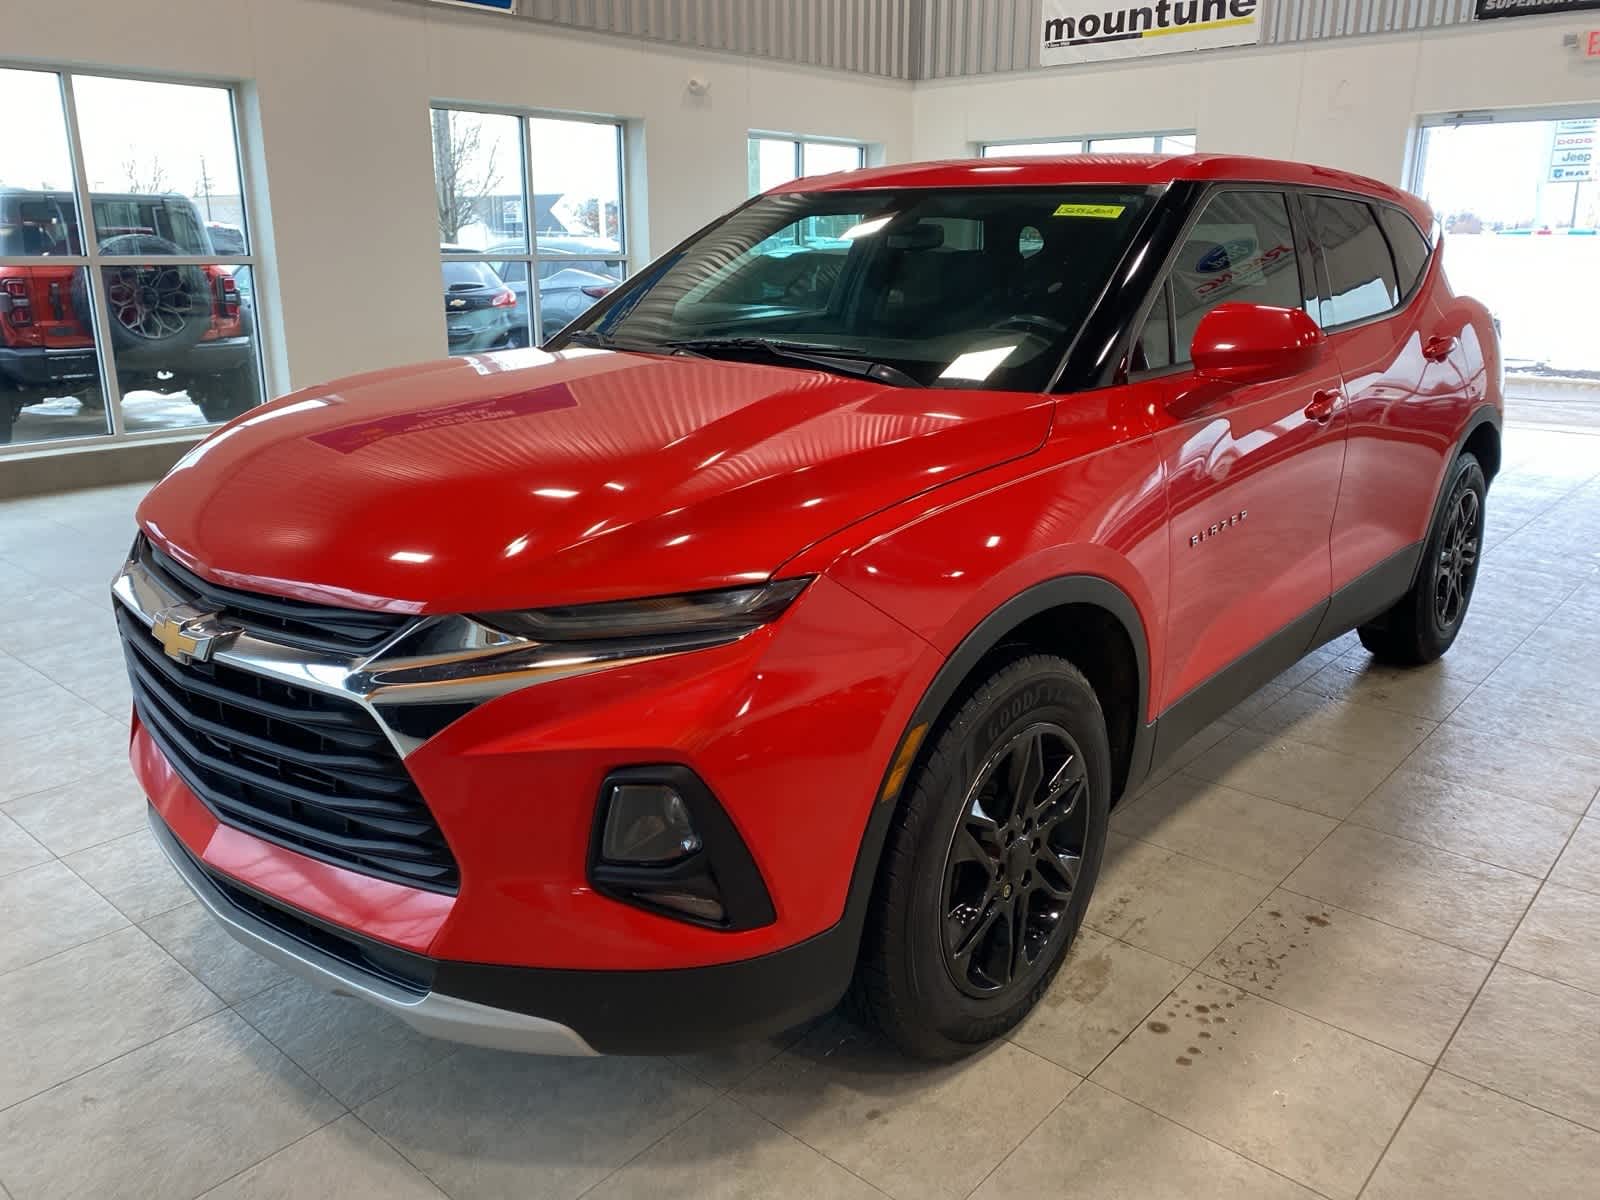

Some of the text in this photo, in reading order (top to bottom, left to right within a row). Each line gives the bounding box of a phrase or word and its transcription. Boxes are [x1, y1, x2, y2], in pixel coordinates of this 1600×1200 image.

[1045, 0, 1256, 41] mountune
[1557, 137, 1592, 146] DODG
[1561, 152, 1592, 163] Jeep
[1189, 509, 1249, 547] BLAZER
